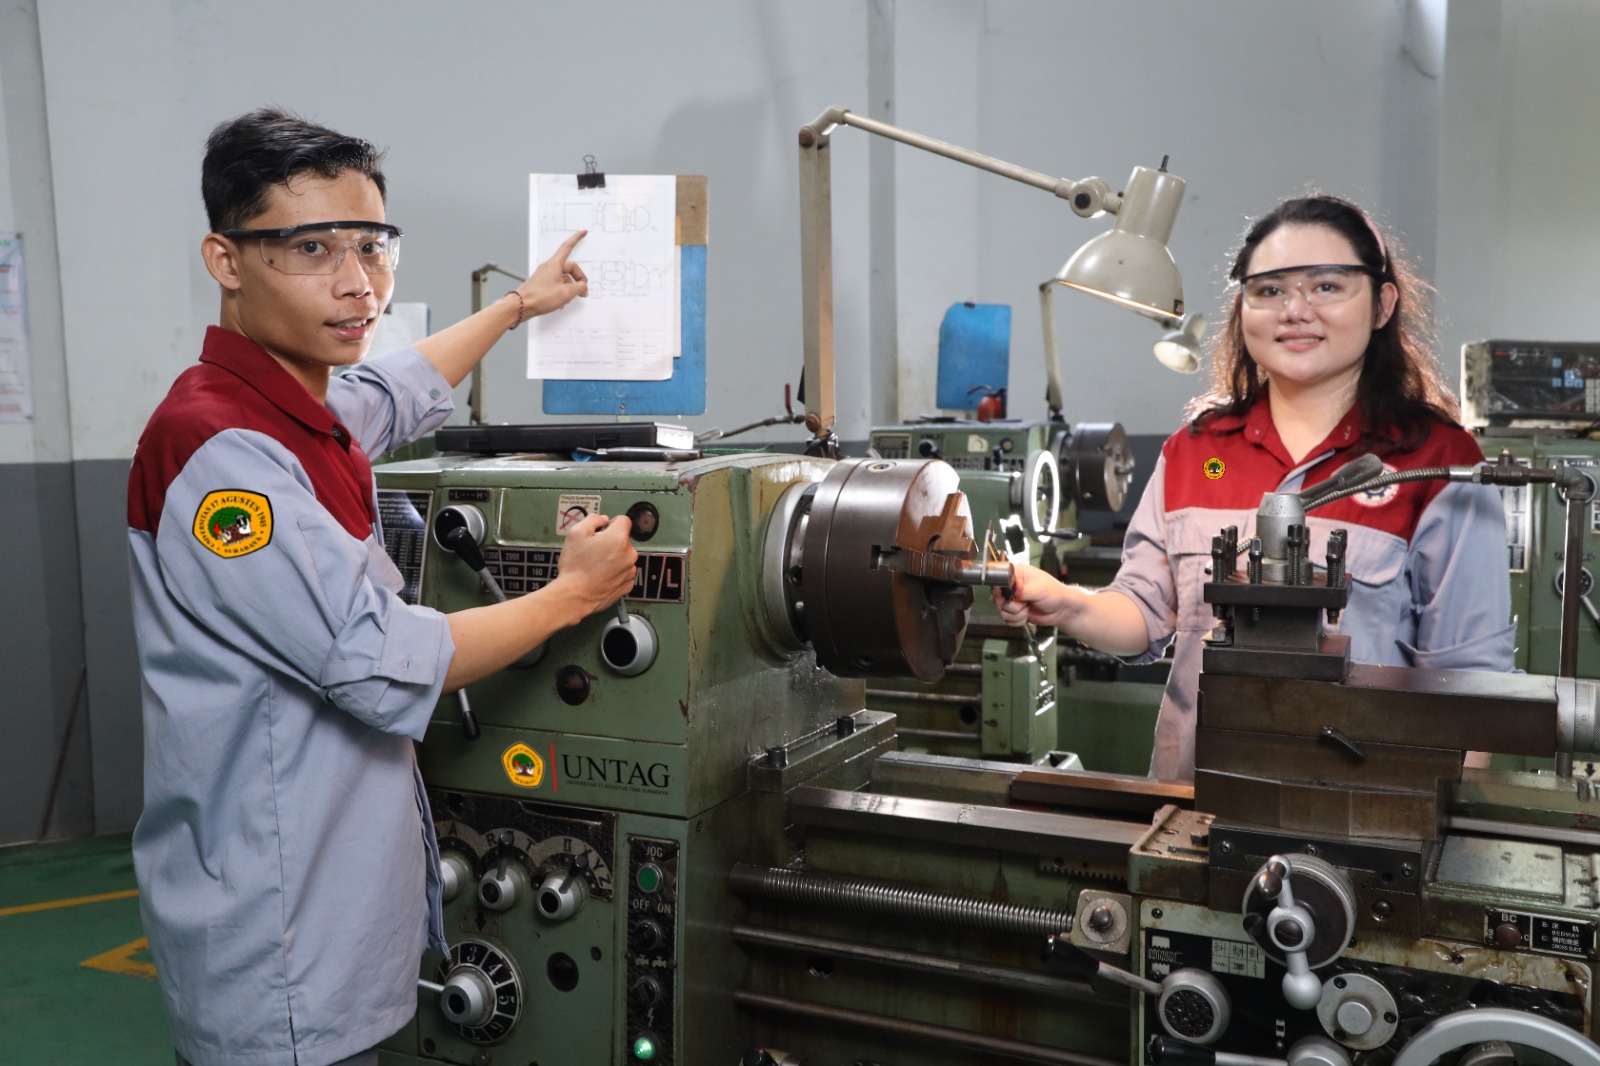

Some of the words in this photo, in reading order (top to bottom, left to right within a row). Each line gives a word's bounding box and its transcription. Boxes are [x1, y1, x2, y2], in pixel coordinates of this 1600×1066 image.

[211, 500, 219, 509] 17
[220, 496, 261, 512] AGUSTUS
[257, 511, 267, 528] 1945
[224, 537, 262, 554] SURABAYA
[533, 553, 545, 562] 650
[532, 567, 543, 576] 160
[667, 568, 679, 588] L
[531, 582, 540, 590] 35
[561, 753, 671, 788] UNTAG
[486, 832, 498, 847] R
[645, 847, 663, 858] JOG
[632, 898, 650, 910] OFF
[657, 903, 671, 914] ON
[1502, 913, 1517, 923] BC
[466, 945, 478, 962] 3
[488, 963, 503, 977] 4
[498, 995, 515, 1006] 5
